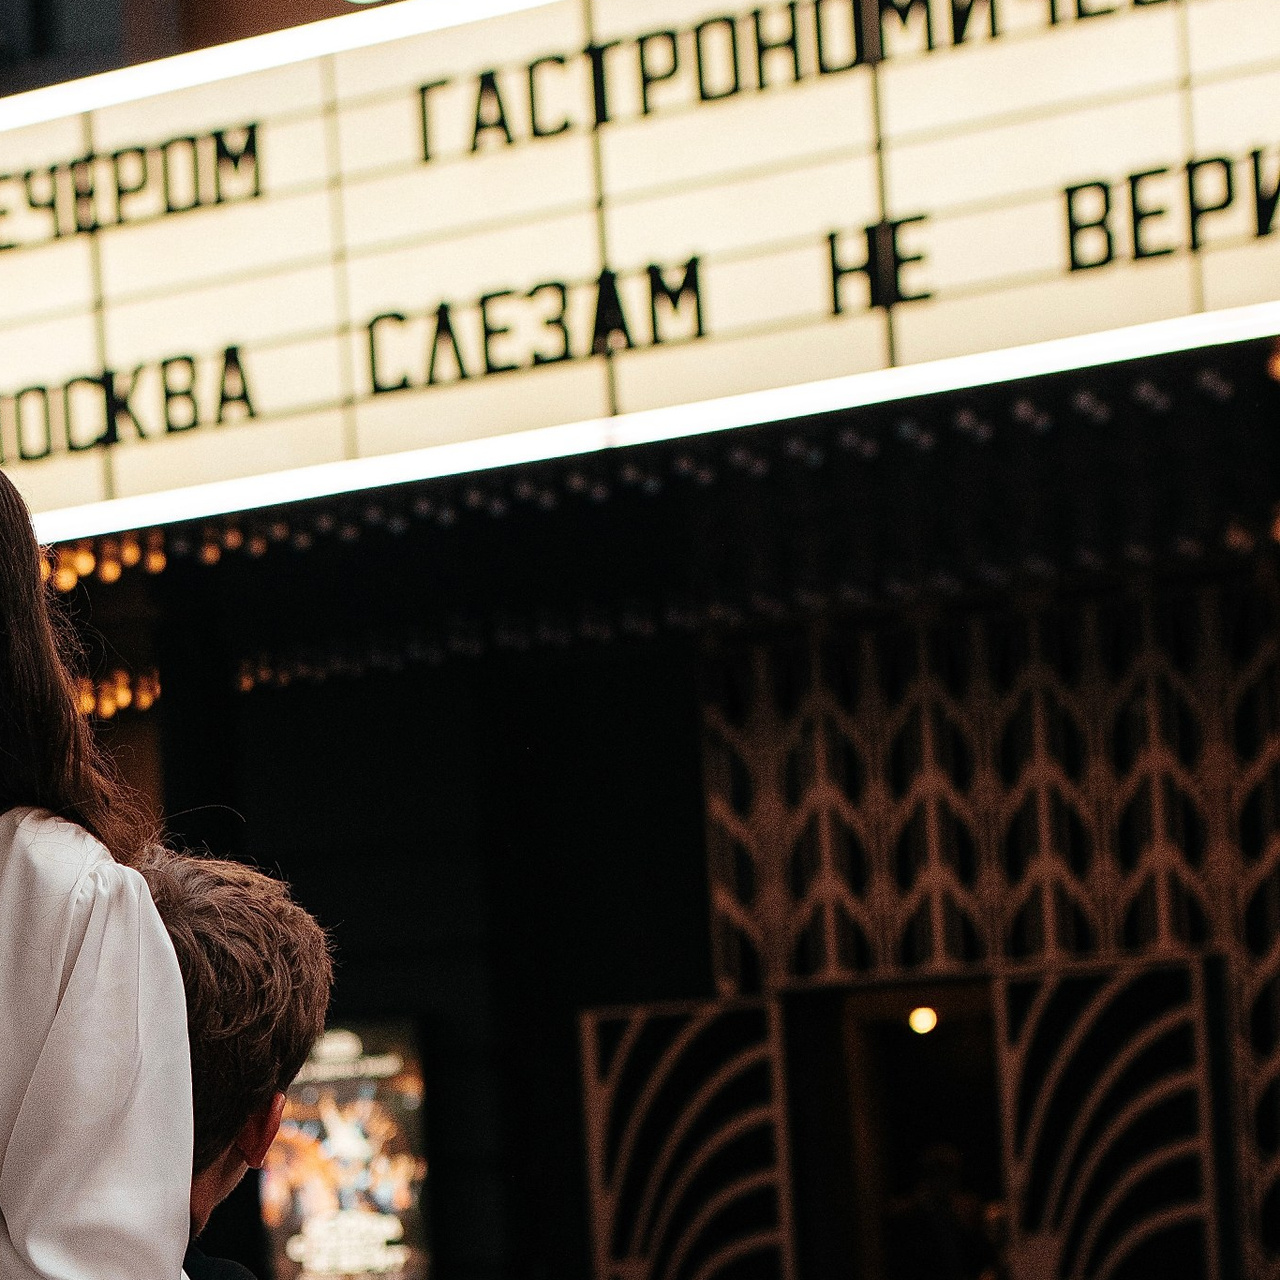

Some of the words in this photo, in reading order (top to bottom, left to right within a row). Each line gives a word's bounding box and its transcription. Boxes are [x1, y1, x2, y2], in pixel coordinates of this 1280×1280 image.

[416, 0, 1168, 164] ГАСТРОНОМИ
[368, 255, 706, 394] СЛЕЗАМ
[826, 214, 934, 316] НЕ
